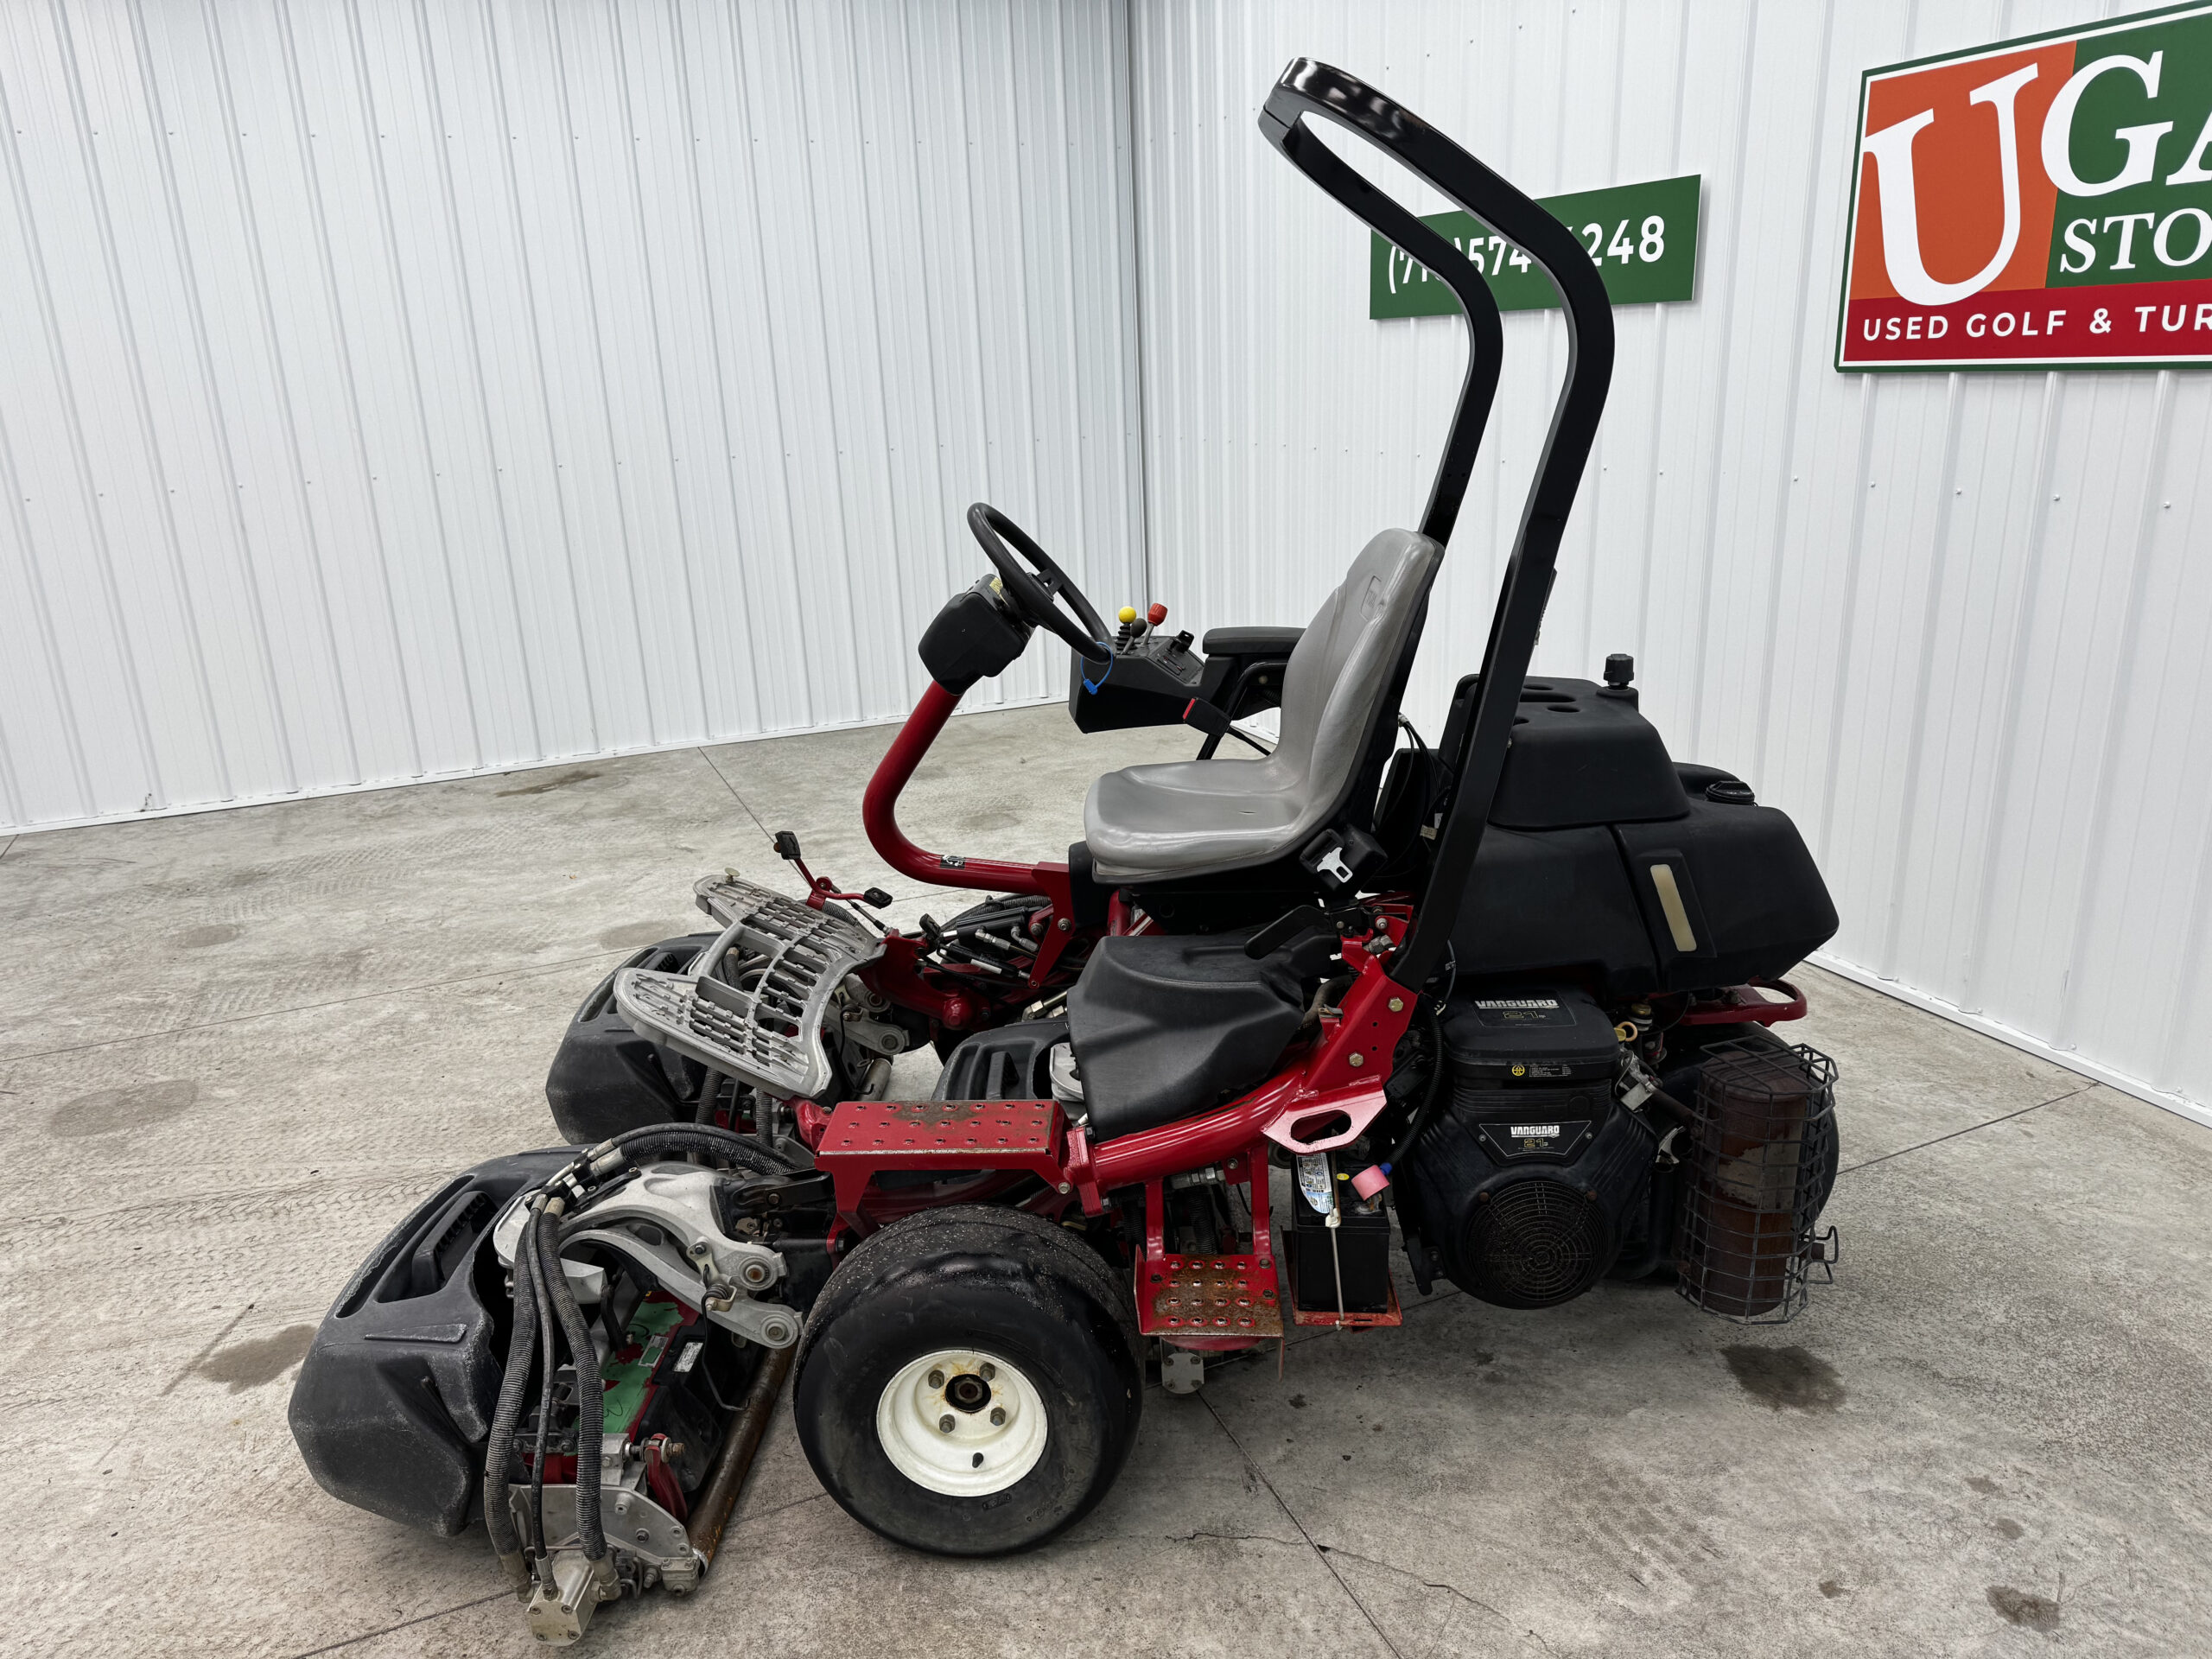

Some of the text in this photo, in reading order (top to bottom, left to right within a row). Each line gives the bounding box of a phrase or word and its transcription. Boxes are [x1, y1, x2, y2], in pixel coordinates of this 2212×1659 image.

[1863, 315, 1948, 341] USED
[1966, 310, 2067, 338] GOLF
[2089, 308, 2112, 334] &
[1474, 999, 1558, 1007] VANGUARD
[1510, 1125, 1560, 1135] VANGUARD
